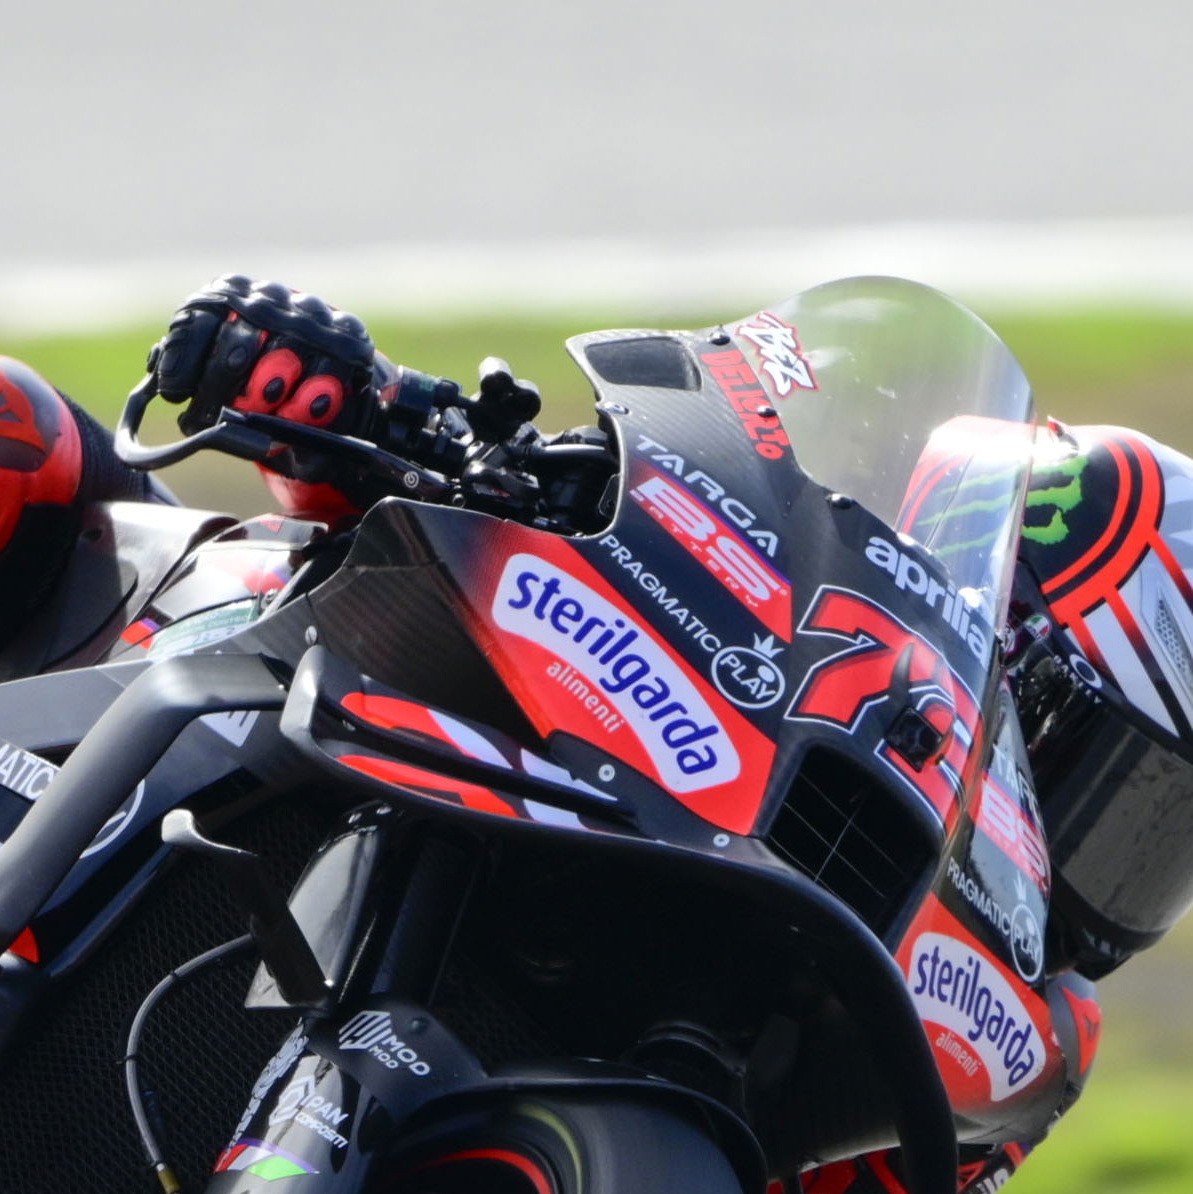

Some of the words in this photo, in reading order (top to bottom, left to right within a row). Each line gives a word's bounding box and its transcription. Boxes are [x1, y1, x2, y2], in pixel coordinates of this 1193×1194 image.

[737, 311, 817, 397] BEZ
[636, 434, 779, 558] TARGA
[636, 476, 781, 601] BS
[599, 534, 722, 653] PRAGMATIC
[718, 653, 776, 700] PLAY
[865, 535, 990, 672] aprilia
[508, 571, 720, 775] sterilgarda
[546, 661, 625, 733] alimenti
[948, 857, 1011, 936] PRAGMATIC
[1013, 926, 1040, 963] PLAY
[368, 1046, 399, 1070] MOD
[381, 1035, 432, 1076] MOD
[914, 945, 1035, 1088] sterilgarda
[935, 1032, 982, 1078] alimenti
